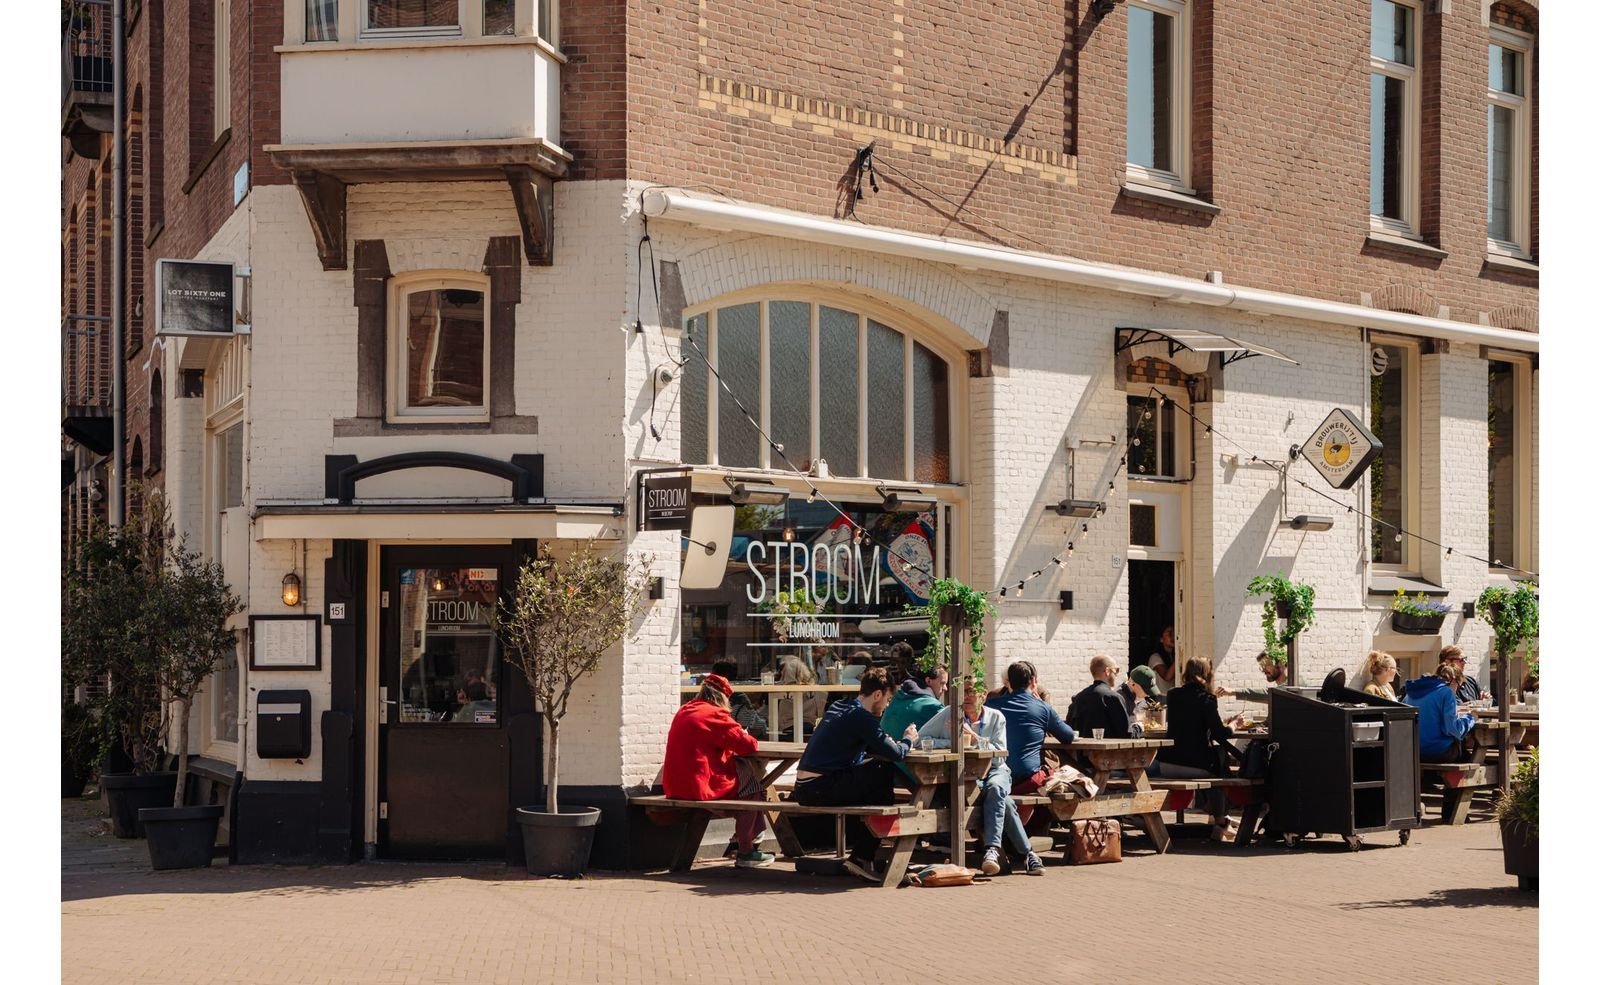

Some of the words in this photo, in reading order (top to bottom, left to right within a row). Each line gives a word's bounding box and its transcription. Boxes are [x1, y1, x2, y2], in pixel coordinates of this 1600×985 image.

[1320, 459, 1354, 473] AMSTERDAM
[648, 488, 687, 508] STROOM
[746, 540, 880, 605] STROOM
[331, 607, 344, 616] 151
[788, 622, 840, 638] LUNCHROOM
